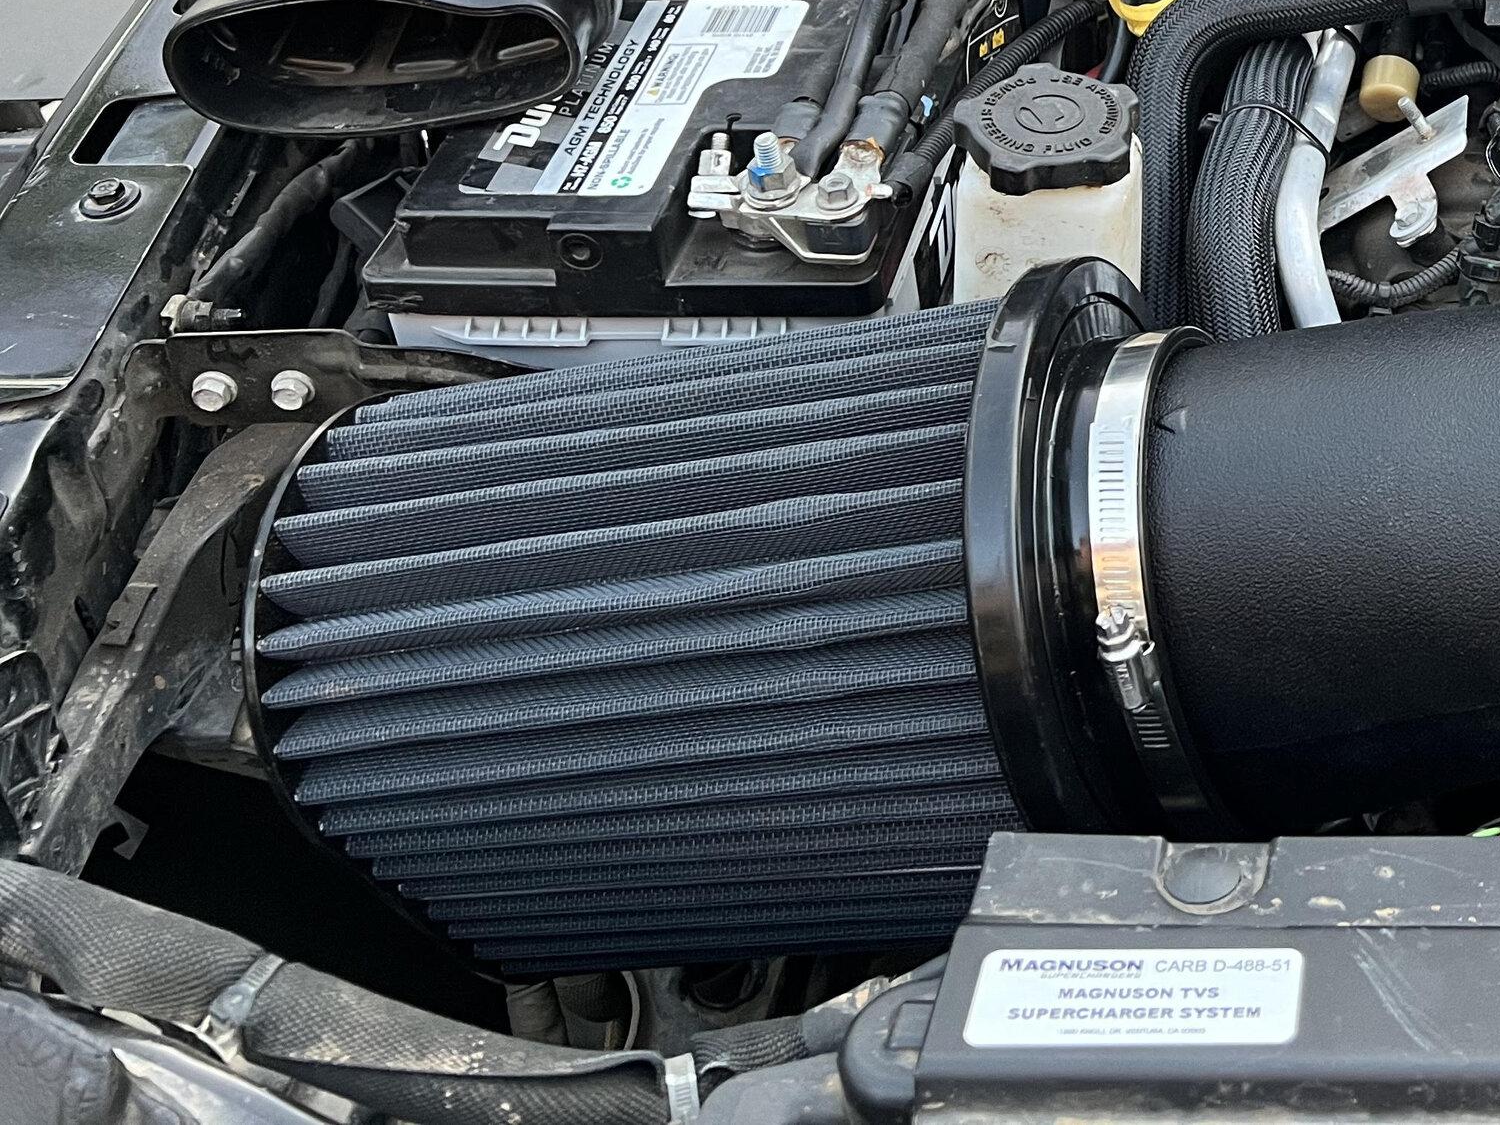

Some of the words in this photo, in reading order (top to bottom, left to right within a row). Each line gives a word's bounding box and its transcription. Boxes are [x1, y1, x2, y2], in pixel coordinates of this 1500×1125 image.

[559, 41, 615, 116] PLATINUM
[564, 125, 589, 157] AGM
[583, 39, 640, 121] TECHNOLOGY
[999, 958, 1144, 972] MAGNUSON
[1155, 959, 1207, 973] CARB
[1213, 959, 1291, 973] D-488-51
[1057, 987, 1173, 1000] MAGNUSON
[1180, 987, 1220, 999] TVS
[1007, 1007, 1174, 1020] SUPERCHARGER
[1179, 1006, 1262, 1019] SYSTEM
